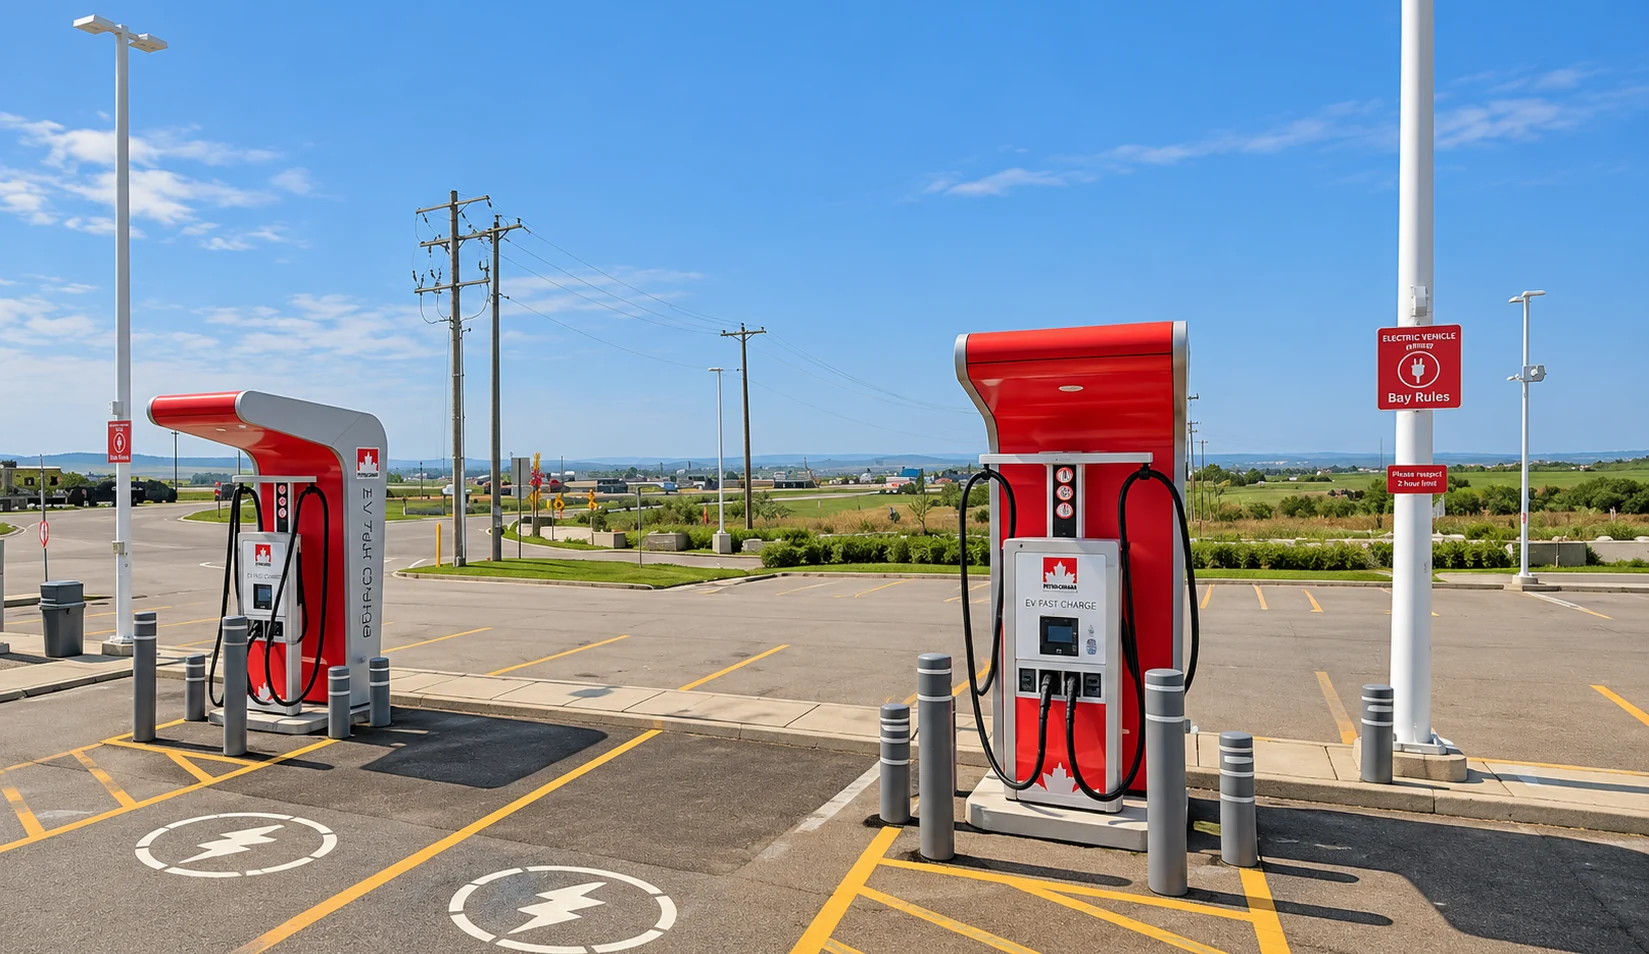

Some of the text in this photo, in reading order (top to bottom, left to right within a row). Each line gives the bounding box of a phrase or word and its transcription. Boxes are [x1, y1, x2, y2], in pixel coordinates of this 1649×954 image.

[1382, 332, 1456, 342] ELECTRIC VEHICLE
[1388, 391, 1450, 405] Bay Rules
[1025, 598, 1097, 610] EV FAST CHARGE
